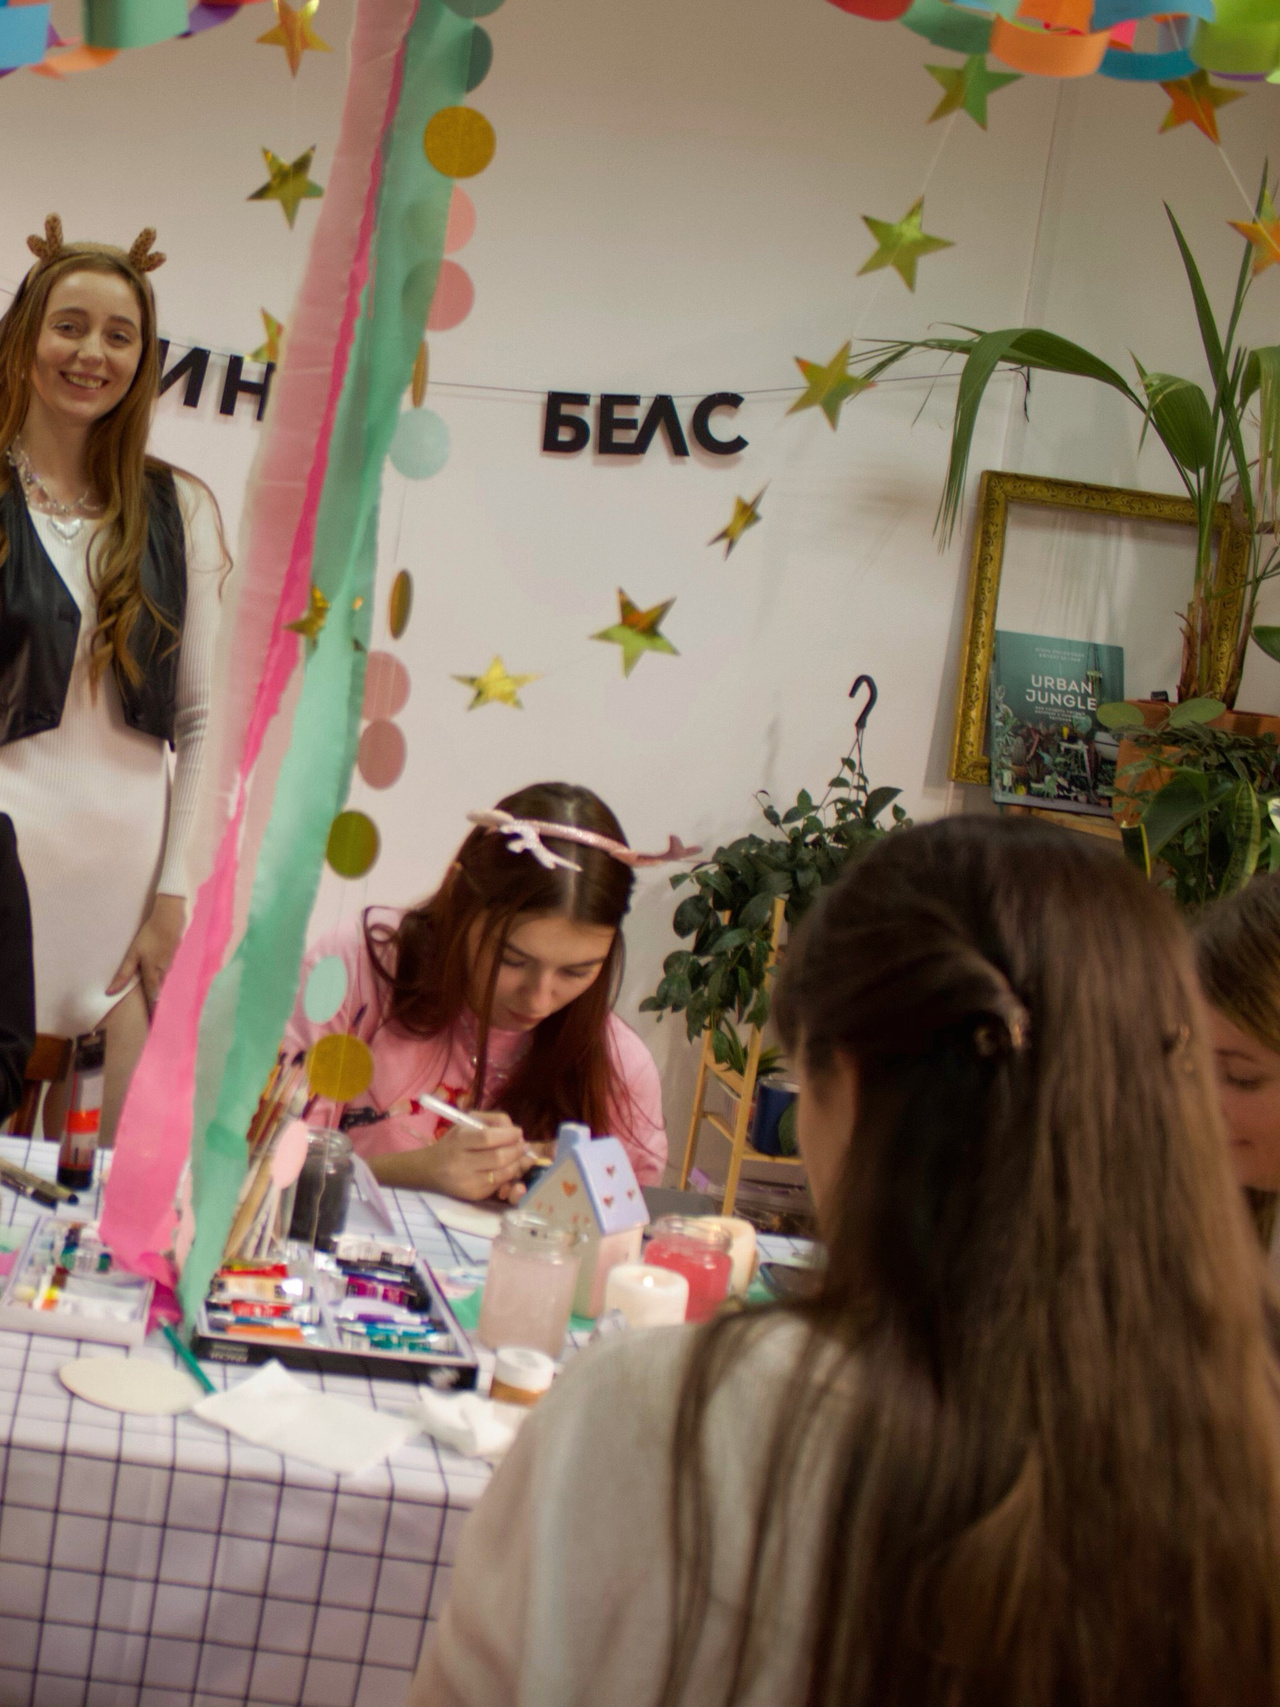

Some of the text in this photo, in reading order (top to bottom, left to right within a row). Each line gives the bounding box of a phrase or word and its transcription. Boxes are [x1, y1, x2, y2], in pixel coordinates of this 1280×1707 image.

[542, 391, 750, 456] БЕЛС
[1031, 674, 1093, 695] URBAN
[1025, 689, 1097, 711] JUNGLE
